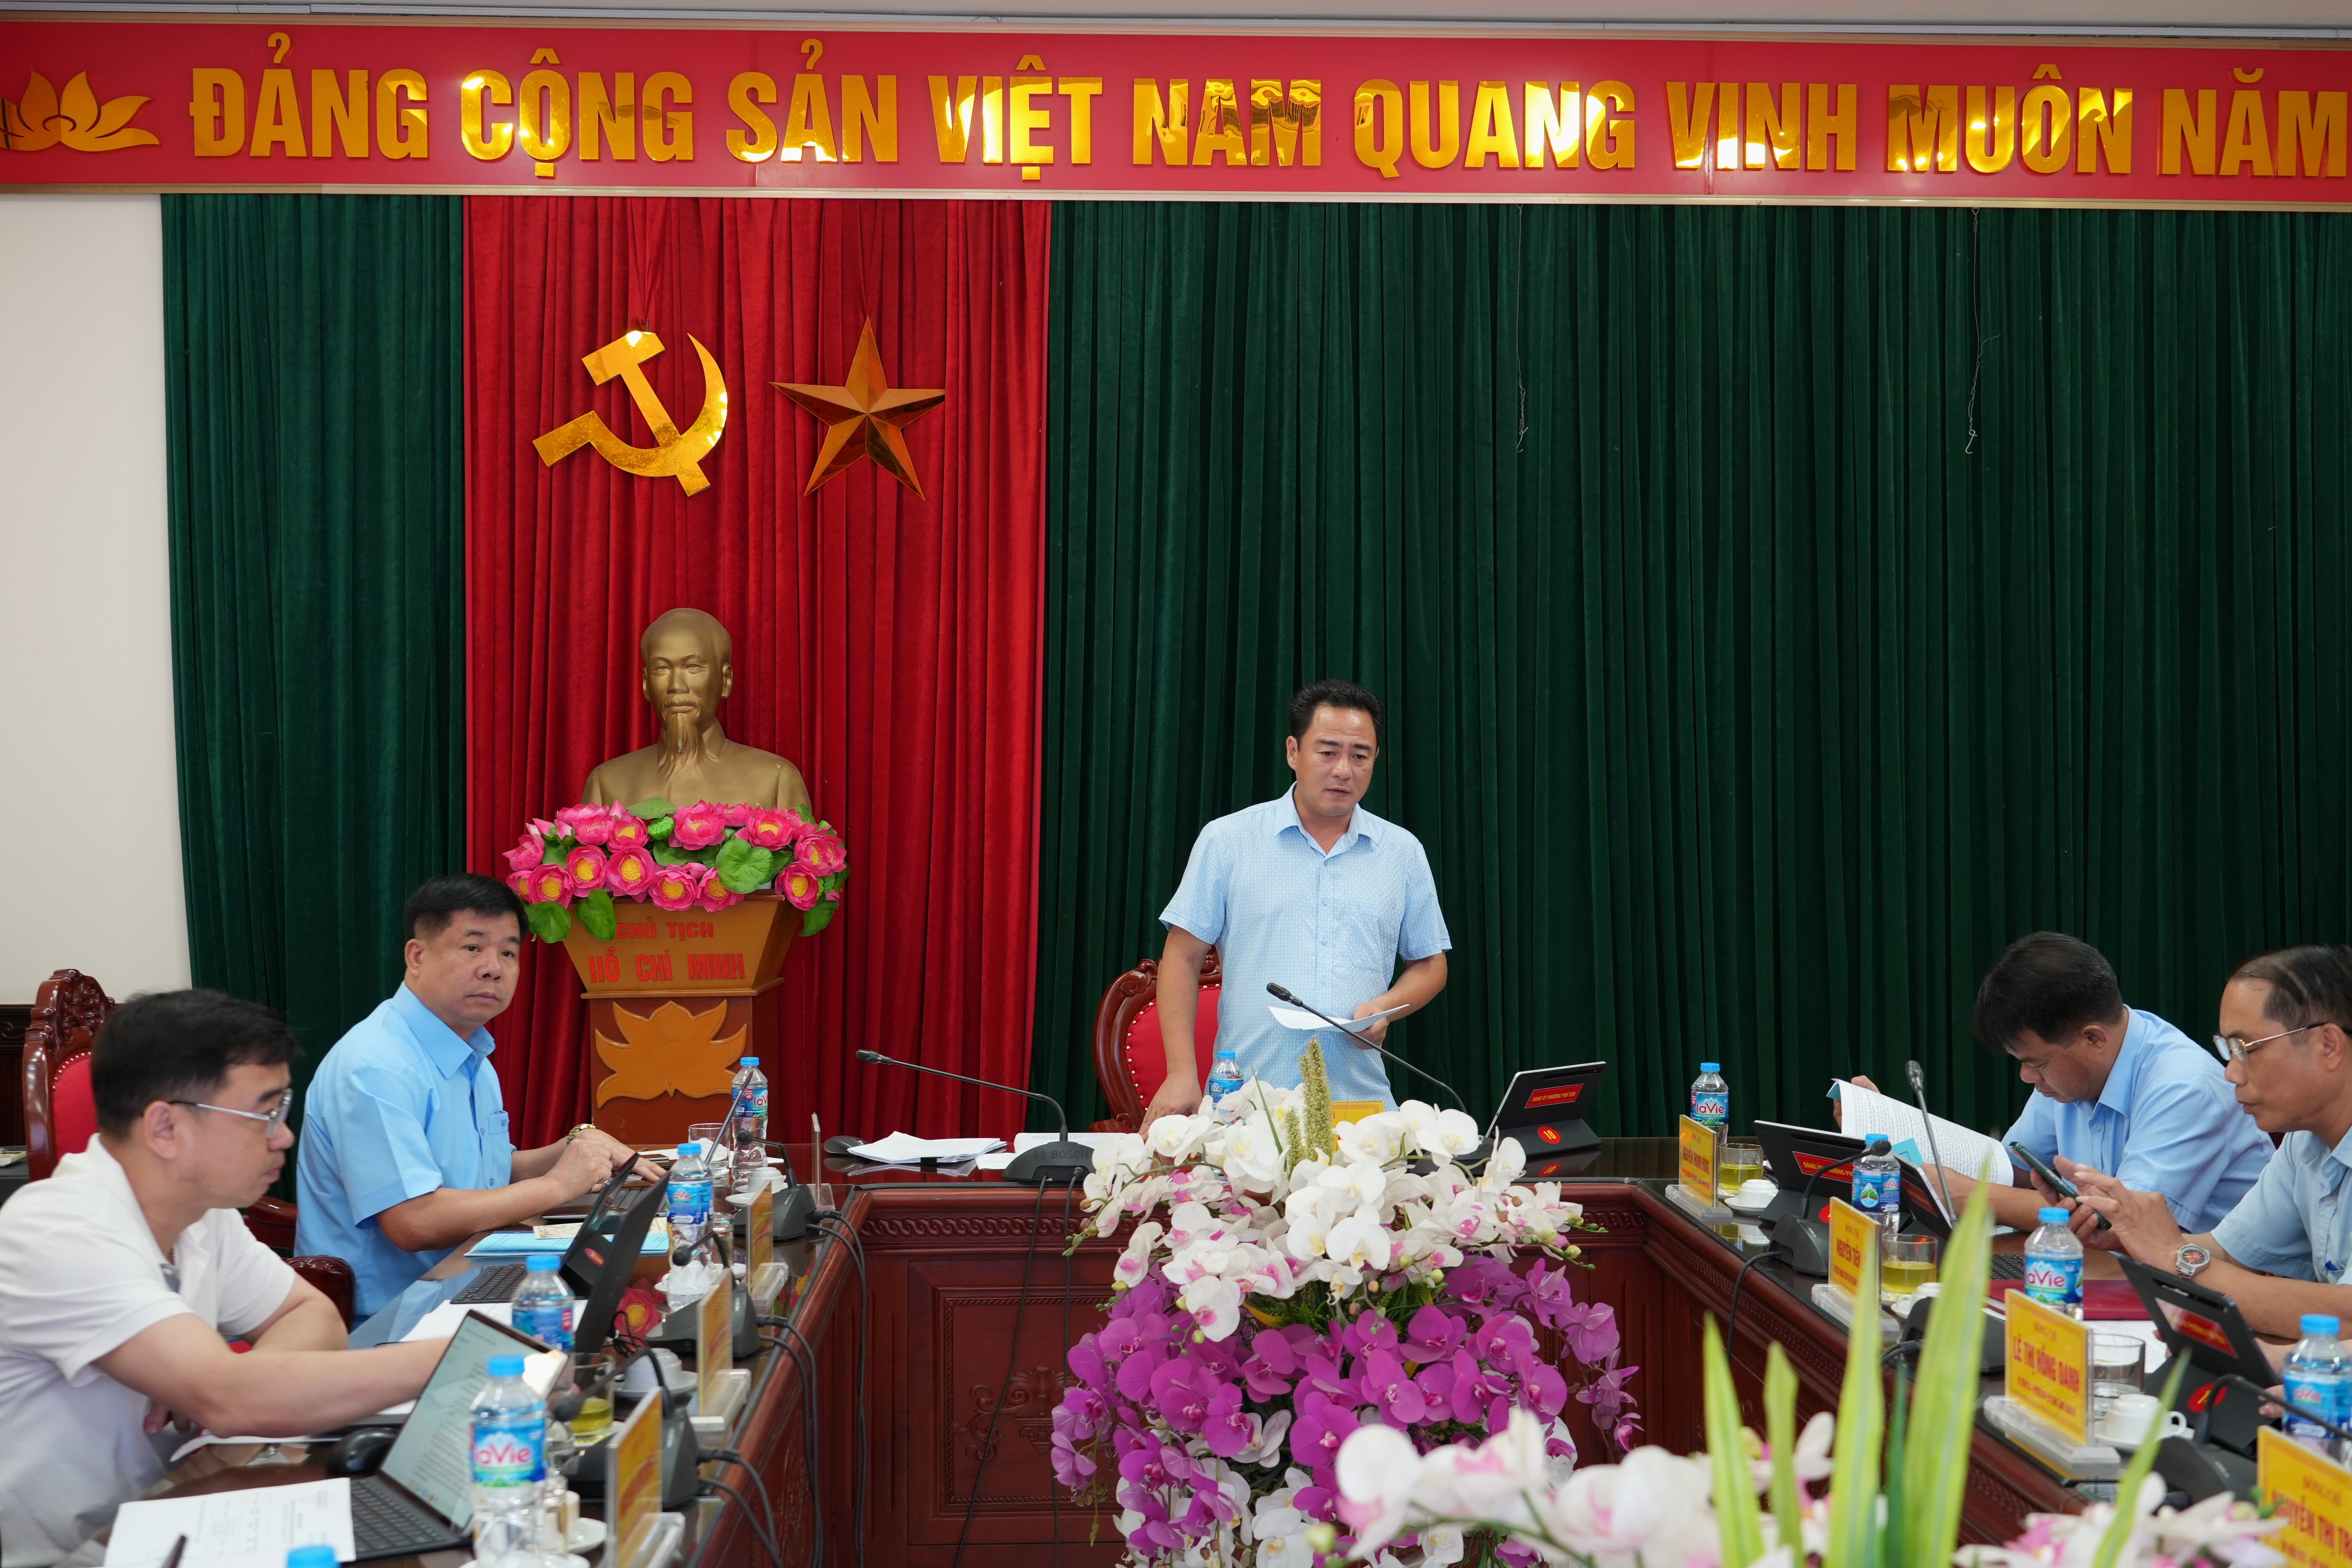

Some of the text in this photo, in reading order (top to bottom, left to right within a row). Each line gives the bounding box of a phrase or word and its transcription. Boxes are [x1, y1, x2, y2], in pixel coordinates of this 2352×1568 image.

[190, 32, 2348, 181] ĐẢNG CỘNG SẢN VIỆT NAM QUANG VINH MUÔN NĂM
[616, 917, 714, 941] CHỦ TỊCH
[589, 947, 745, 983] HỒ CHÍ MINH
[1697, 1102, 1725, 1114] laVie
[1543, 1130, 1557, 1140] 10
[1051, 1150, 1089, 1160] BOSCH
